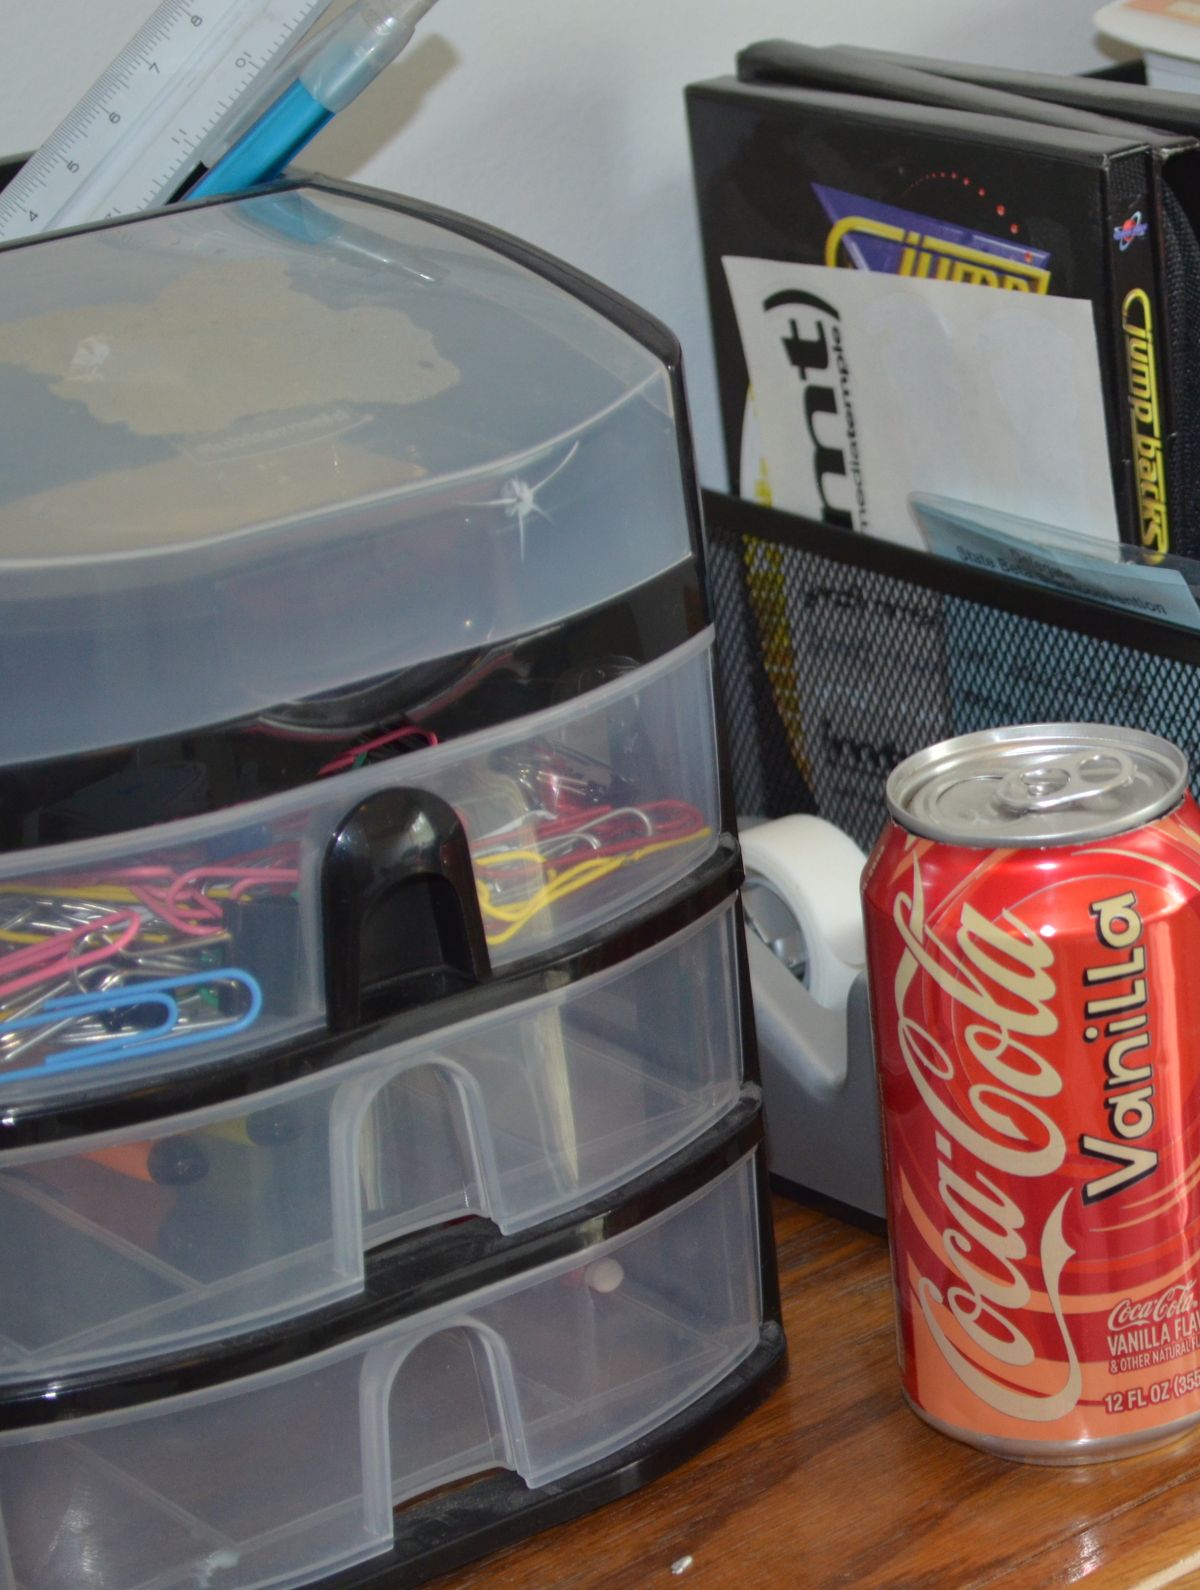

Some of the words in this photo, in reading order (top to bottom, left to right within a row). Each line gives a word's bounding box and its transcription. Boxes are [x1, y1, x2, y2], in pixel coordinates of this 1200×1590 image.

[190, 15, 203, 27] 8
[149, 62, 161, 74] 7
[109, 112, 121, 124] 6
[67, 161, 80, 173] 5
[28, 210, 38, 222] 4
[892, 850, 1083, 1423] Coca-Cola
[1107, 1278, 1197, 1332] Coca-Cola
[1107, 1323, 1171, 1356] VANILLA
[1110, 1360, 1118, 1373] &
[1120, 1354, 1150, 1371] OTHER
[1152, 1342, 1190, 1363] NATURAL
[1105, 1393, 1124, 1412] 12
[1128, 1387, 1147, 1409] FL
[1150, 1381, 1171, 1403] OZ
[1174, 1369, 1200, 1397] (355
